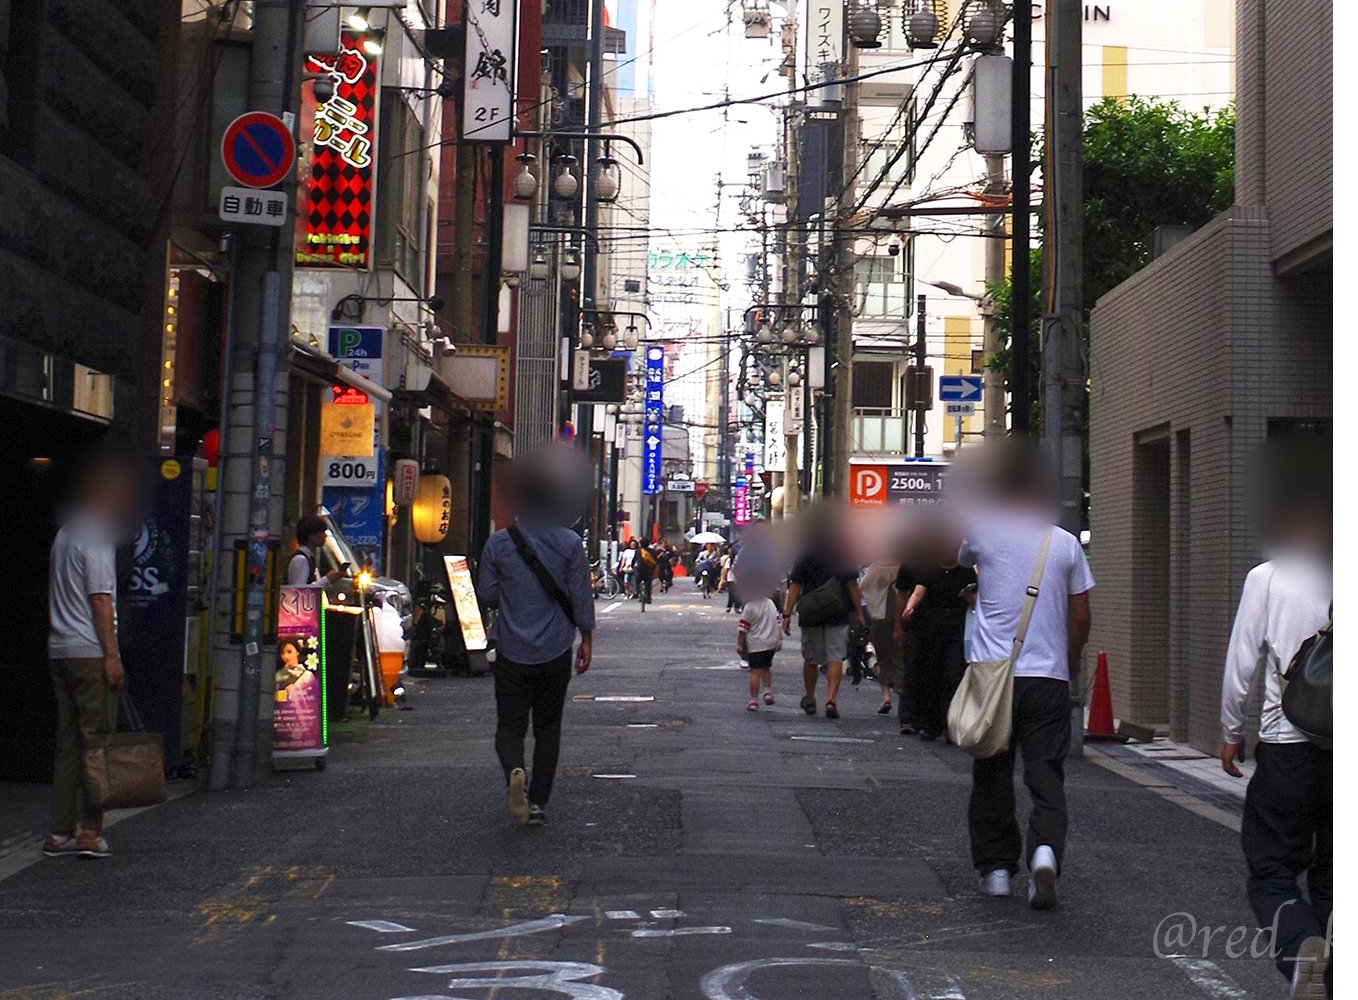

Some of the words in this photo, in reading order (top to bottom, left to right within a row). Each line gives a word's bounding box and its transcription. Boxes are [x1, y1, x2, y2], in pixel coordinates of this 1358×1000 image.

[475, 107, 500, 122] 2F
[223, 195, 284, 218] 自動車
[338, 328, 362, 358] P
[348, 348, 368, 357] 24h
[328, 463, 376, 480] 800円
[891, 478, 931, 490] 2500円
